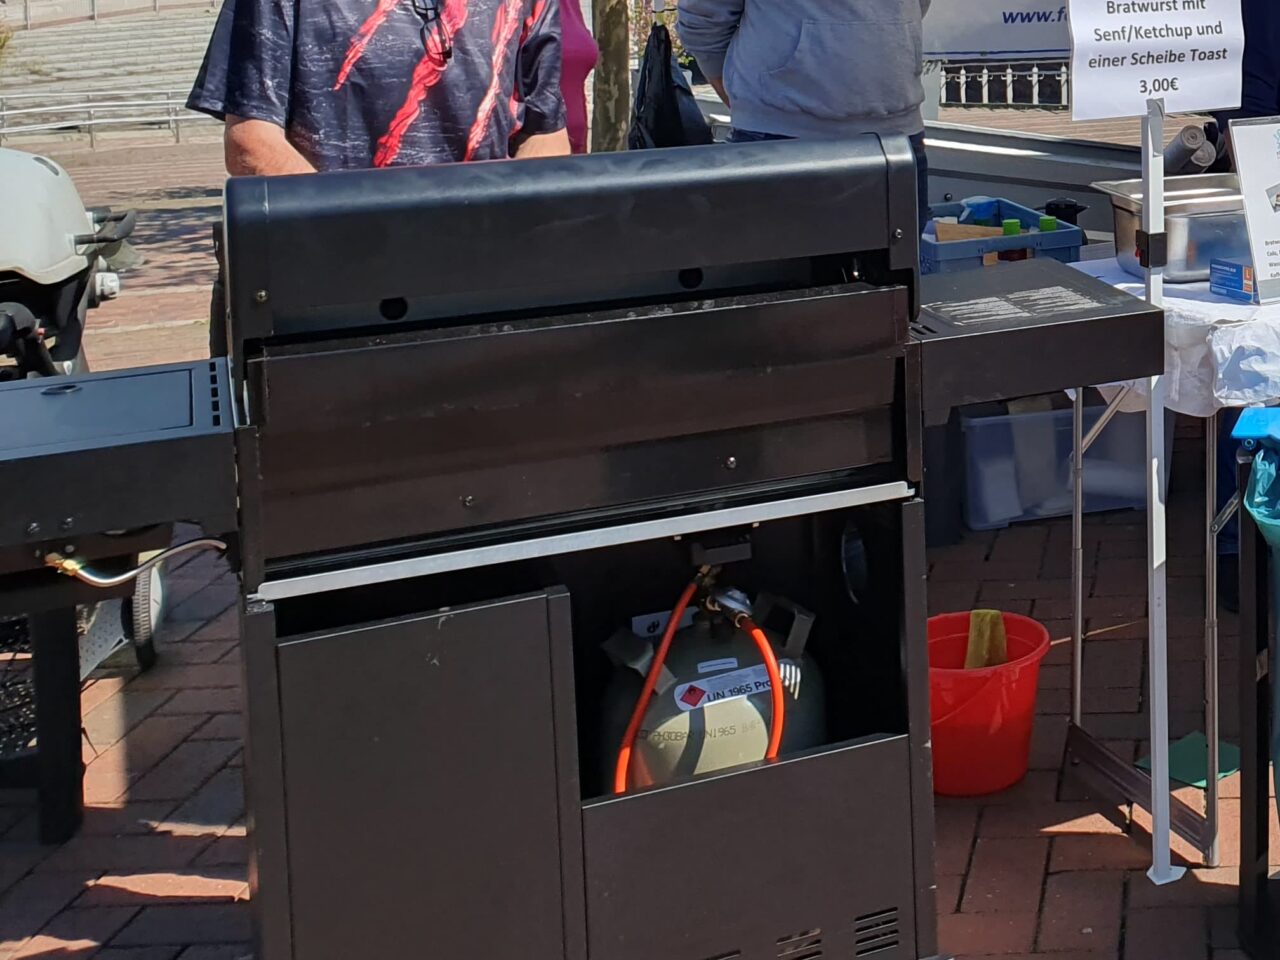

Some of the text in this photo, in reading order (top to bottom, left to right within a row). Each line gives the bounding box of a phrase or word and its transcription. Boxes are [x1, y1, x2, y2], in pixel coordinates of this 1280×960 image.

[1002, 6, 1067, 24] www.f
[1094, 21, 1223, 42] Senf/Ketchup und
[1088, 48, 1228, 68] einer Scheibe Toast
[1139, 77, 1179, 95] 3,00€
[728, 683, 753, 696] 1965
